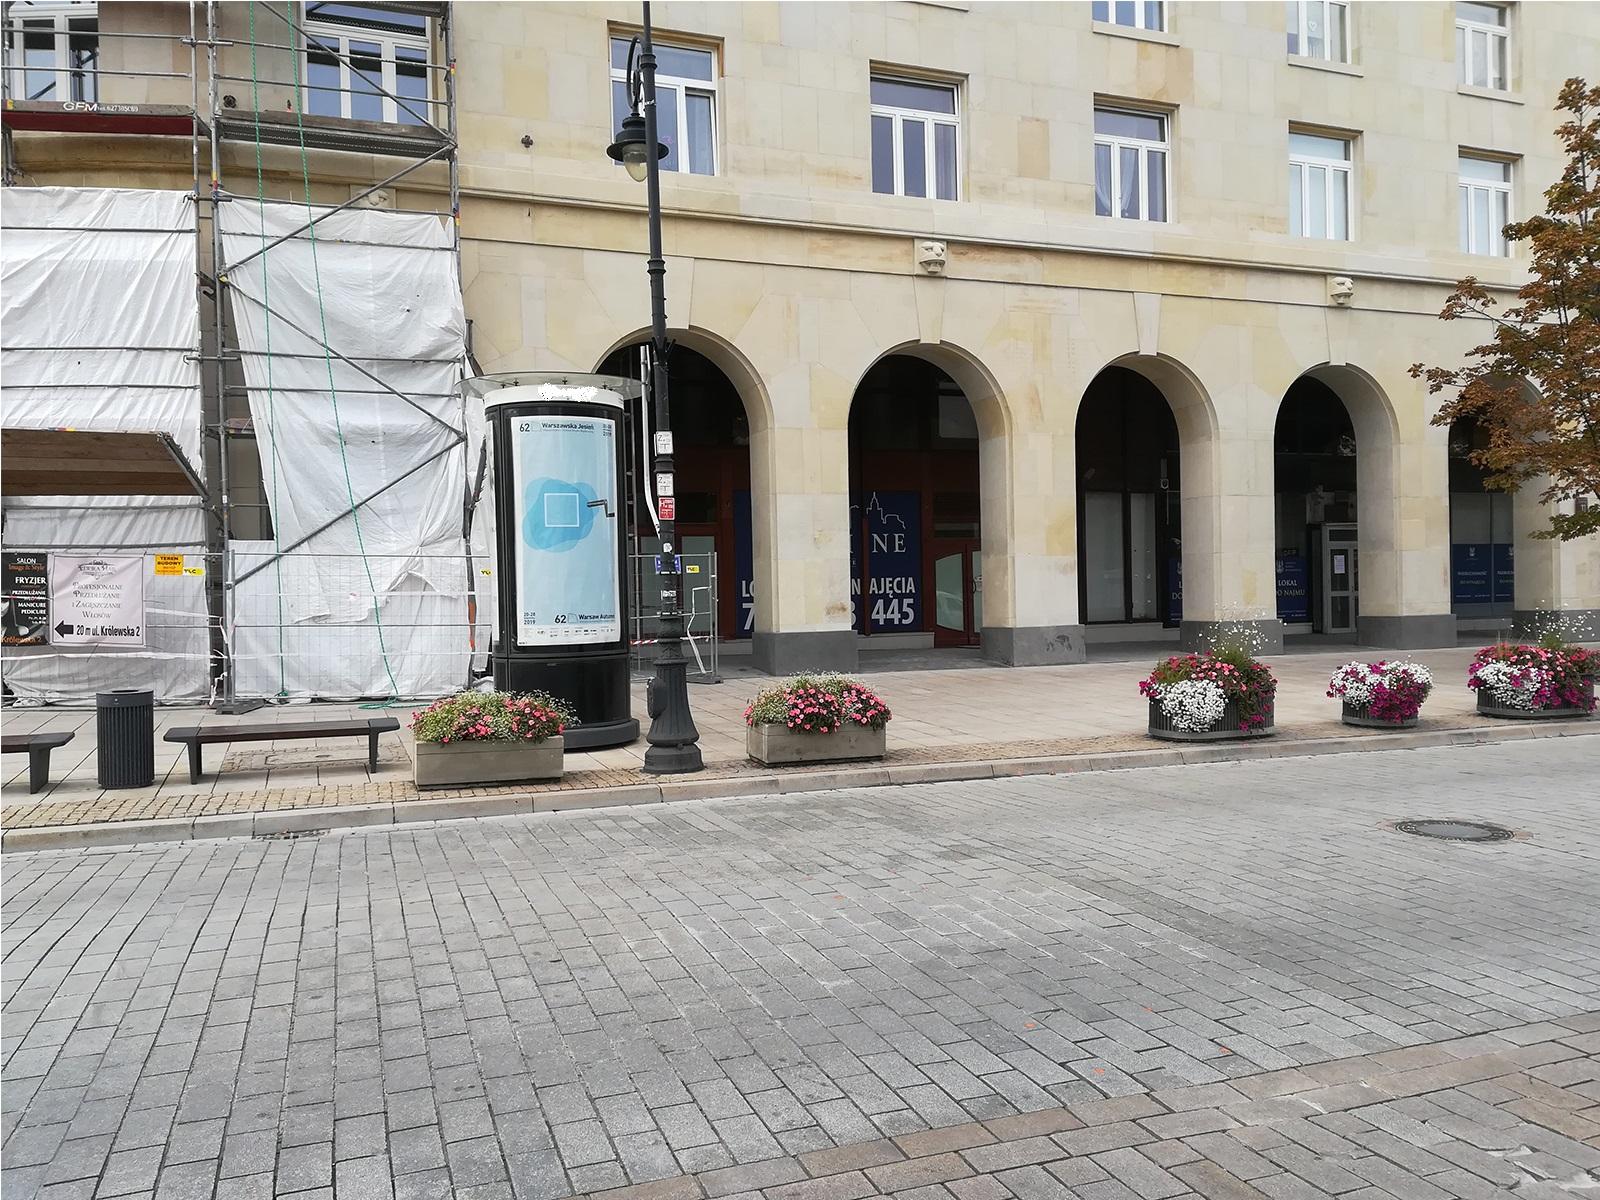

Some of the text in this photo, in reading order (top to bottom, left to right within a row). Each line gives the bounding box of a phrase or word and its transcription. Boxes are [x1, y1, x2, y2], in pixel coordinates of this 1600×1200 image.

[63, 102, 97, 111] GFM
[520, 423, 530, 432] 62
[871, 598, 915, 625] 445
[554, 615, 567, 624] 62
[76, 625, 84, 635] 20
[85, 627, 91, 635] m
[100, 625, 135, 636] Królewska
[135, 626, 141, 636] 2
